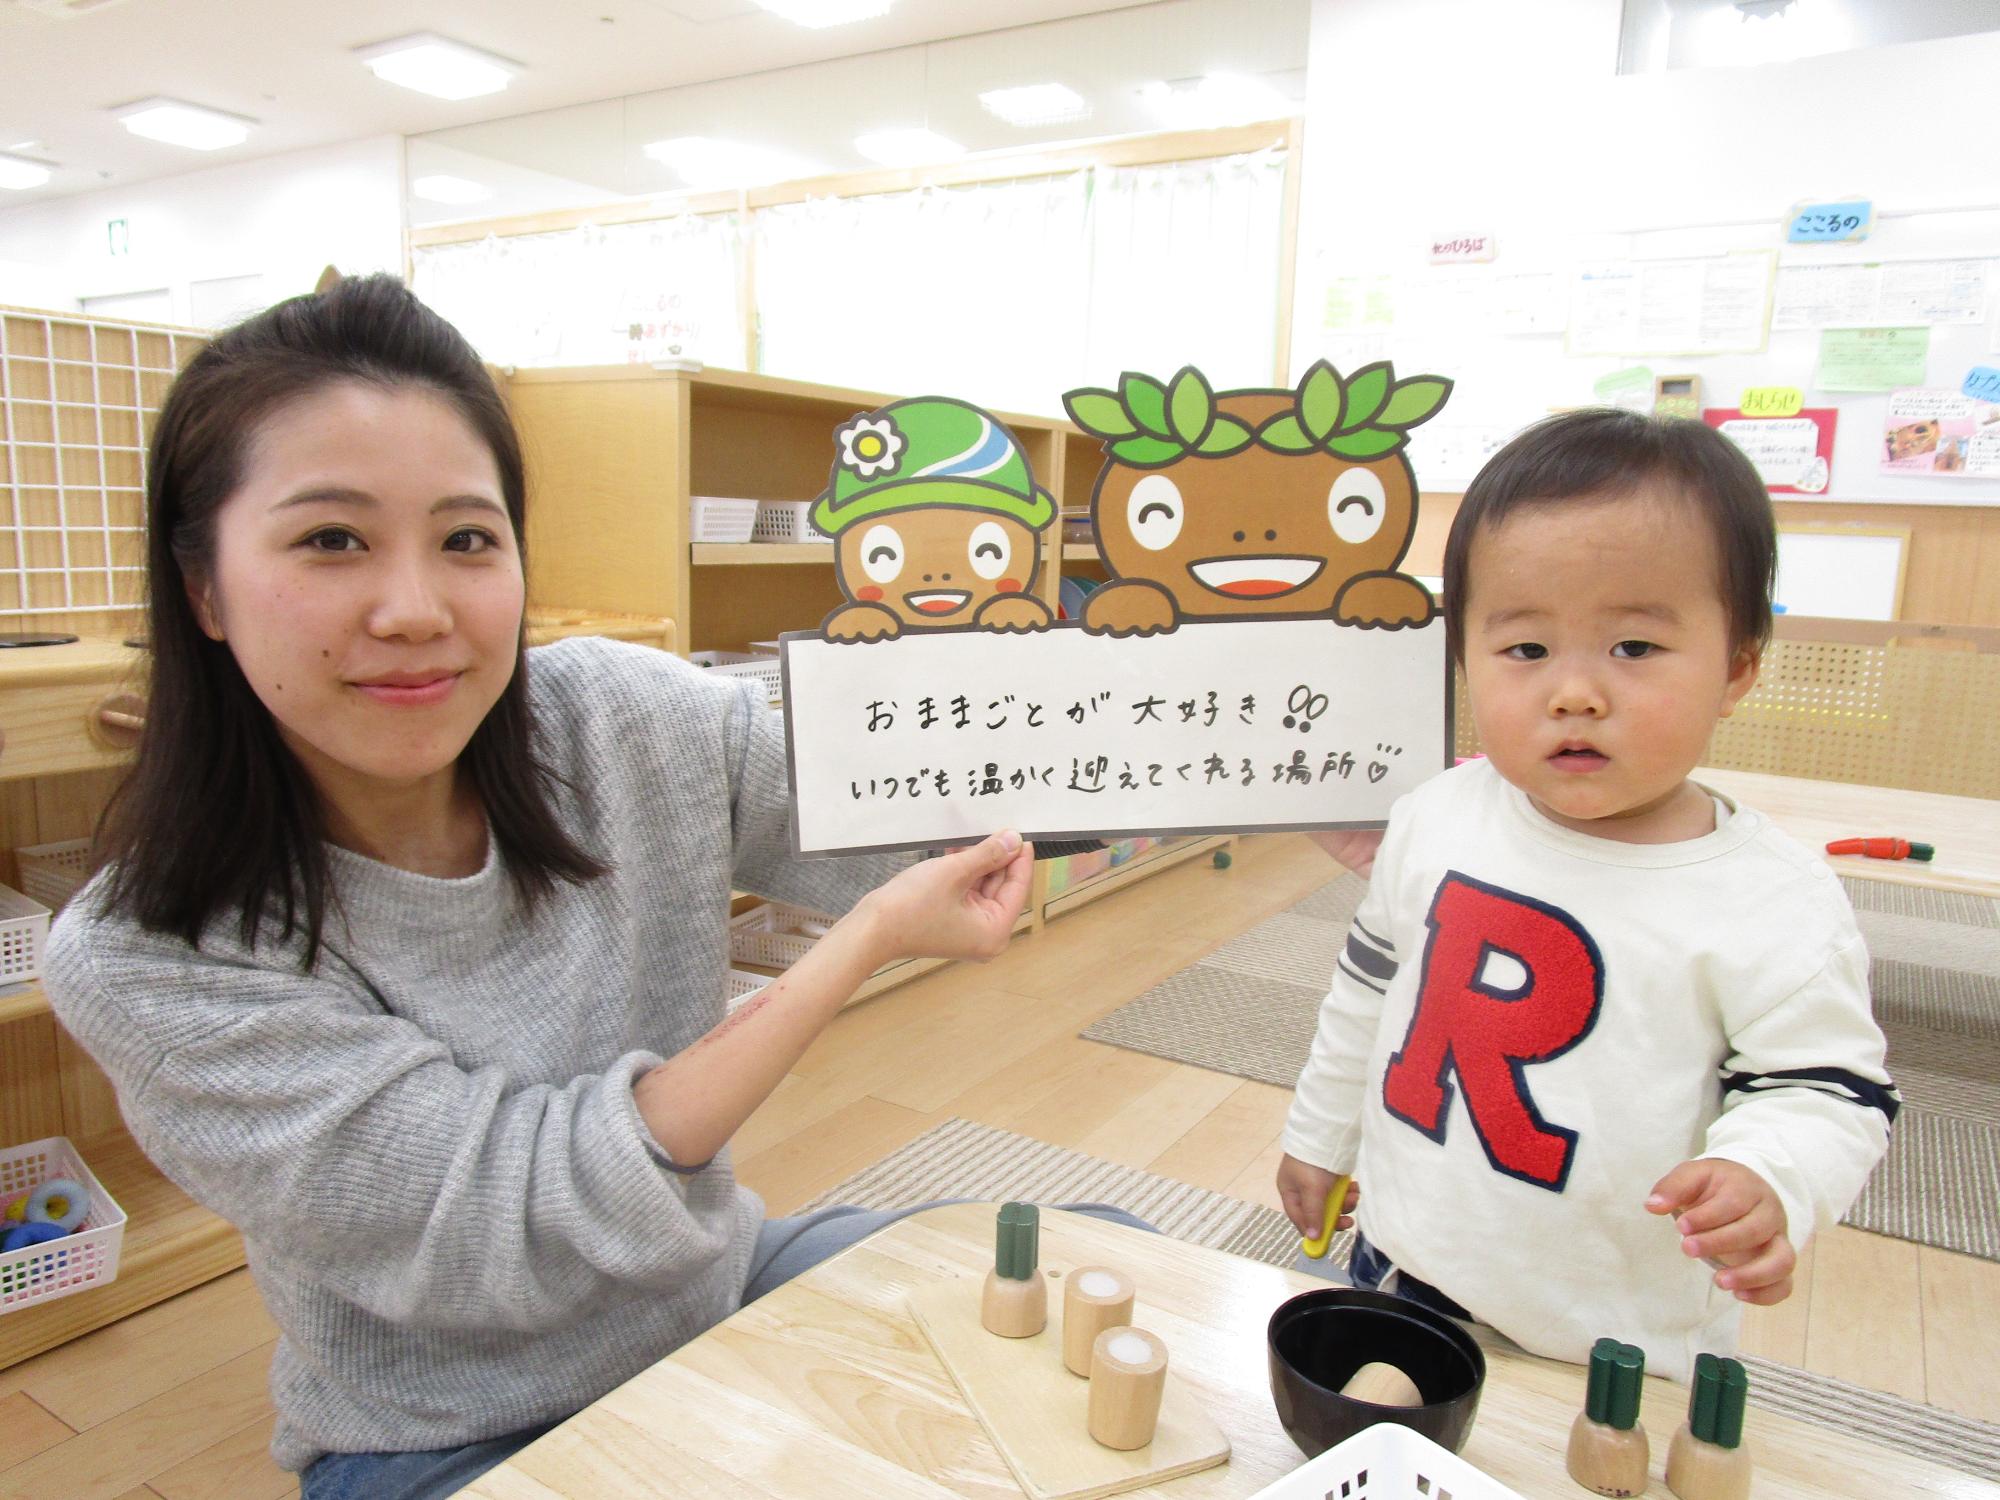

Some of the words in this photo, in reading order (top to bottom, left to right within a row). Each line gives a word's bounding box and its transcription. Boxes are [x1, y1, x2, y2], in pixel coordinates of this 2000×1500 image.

[1742, 389, 1796, 411] おしらせ
[851, 749, 1356, 800] いつでも温かく迎えてくれる場所
[1383, 870, 1606, 1193] R
